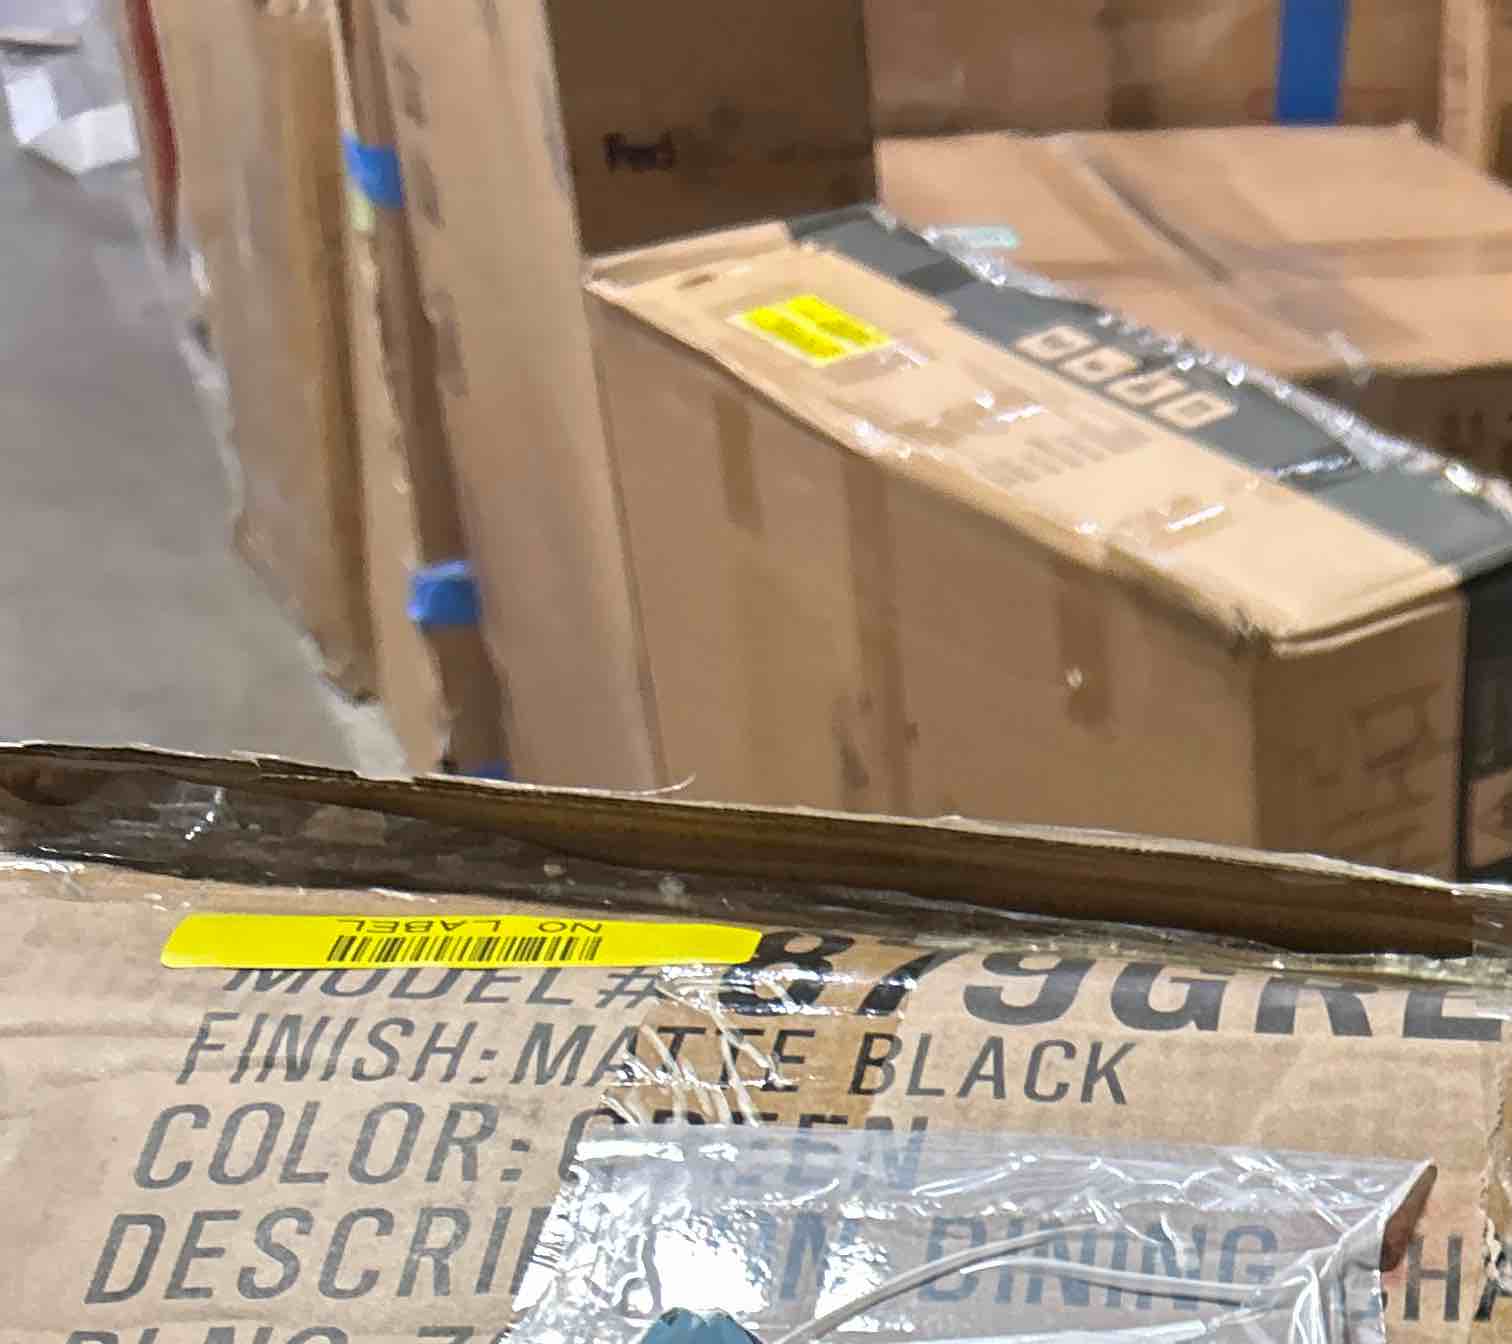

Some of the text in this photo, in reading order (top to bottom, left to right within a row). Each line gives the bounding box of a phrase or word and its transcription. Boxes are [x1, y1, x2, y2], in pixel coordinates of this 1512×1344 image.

[336, 919, 603, 934] NO LABEL
[848, 1032, 1137, 1108] BLACK
[133, 1102, 928, 1196] COLOR: GEEN
[916, 1213, 1281, 1313] DINING
